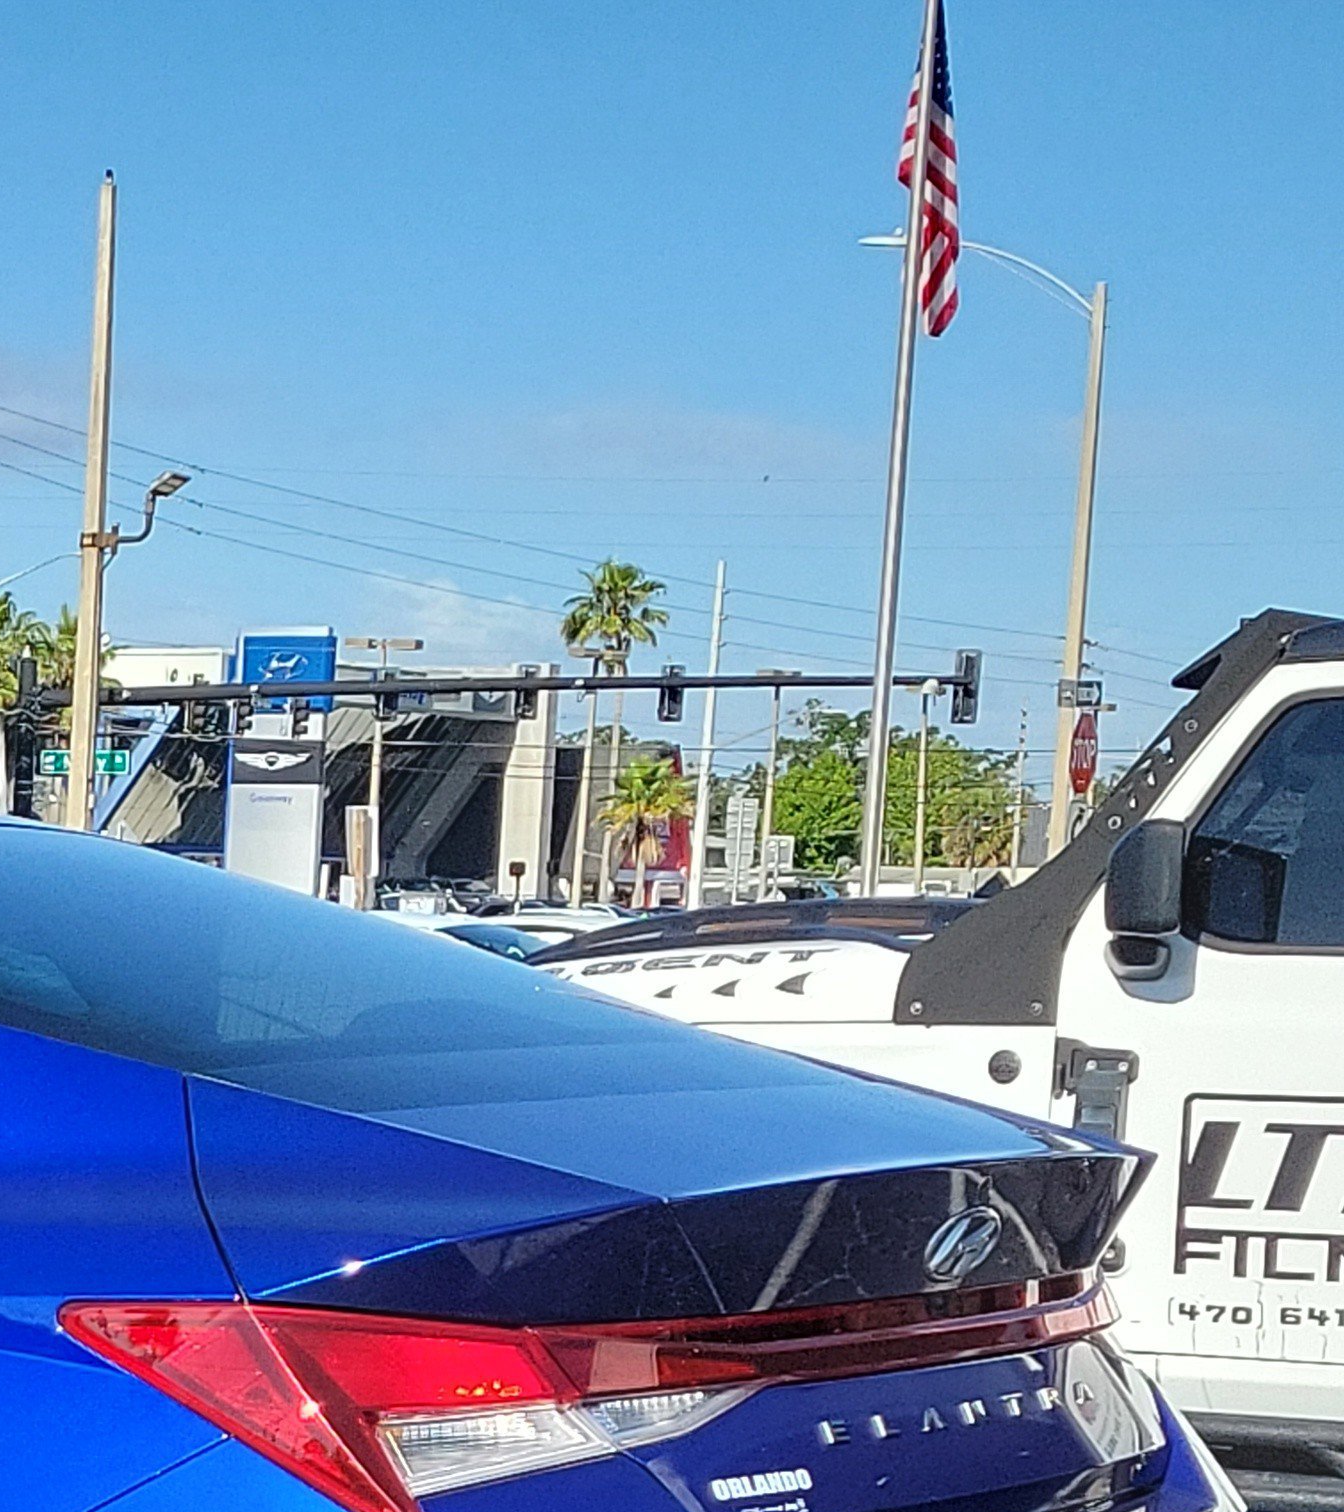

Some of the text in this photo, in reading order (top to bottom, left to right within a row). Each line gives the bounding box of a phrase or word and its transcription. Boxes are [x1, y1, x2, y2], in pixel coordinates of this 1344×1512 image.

[1072, 736, 1097, 771] STOP
[1180, 1120, 1344, 1213] LT
[817, 1381, 1095, 1445] ELANTRA
[712, 1468, 813, 1501] ORLANDO
